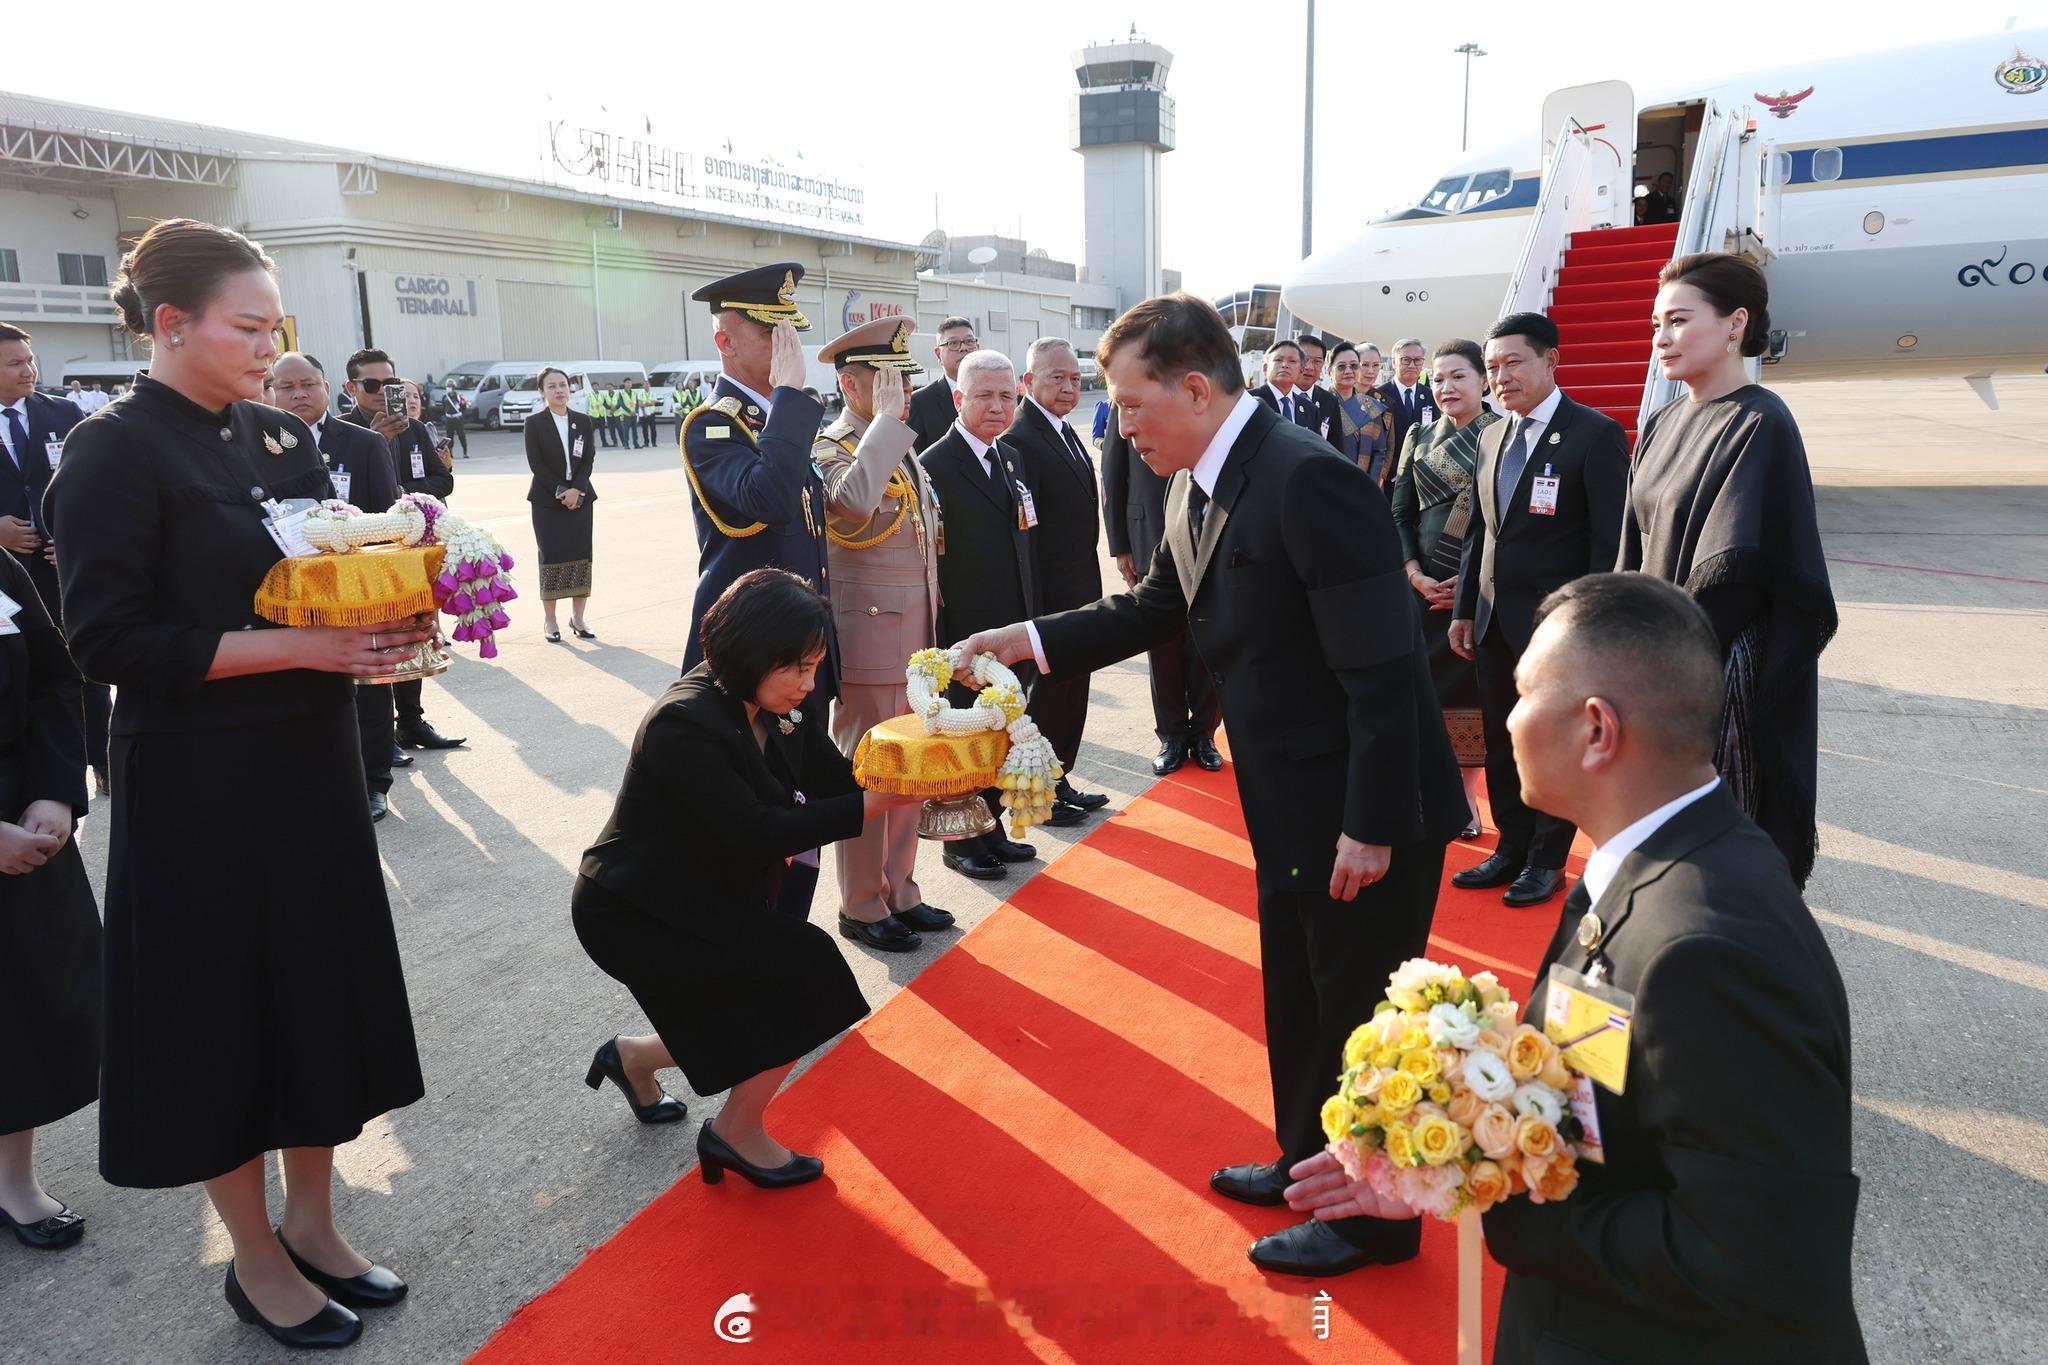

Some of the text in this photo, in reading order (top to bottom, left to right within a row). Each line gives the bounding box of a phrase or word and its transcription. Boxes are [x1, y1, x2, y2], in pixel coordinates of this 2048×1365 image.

[705, 185, 788, 212] INTERNATIONAL
[788, 200, 822, 218] CARGO
[1958, 245, 2048, 287] ๙๐
[395, 276, 450, 295] CARGO
[397, 297, 468, 316] TERMINAL
